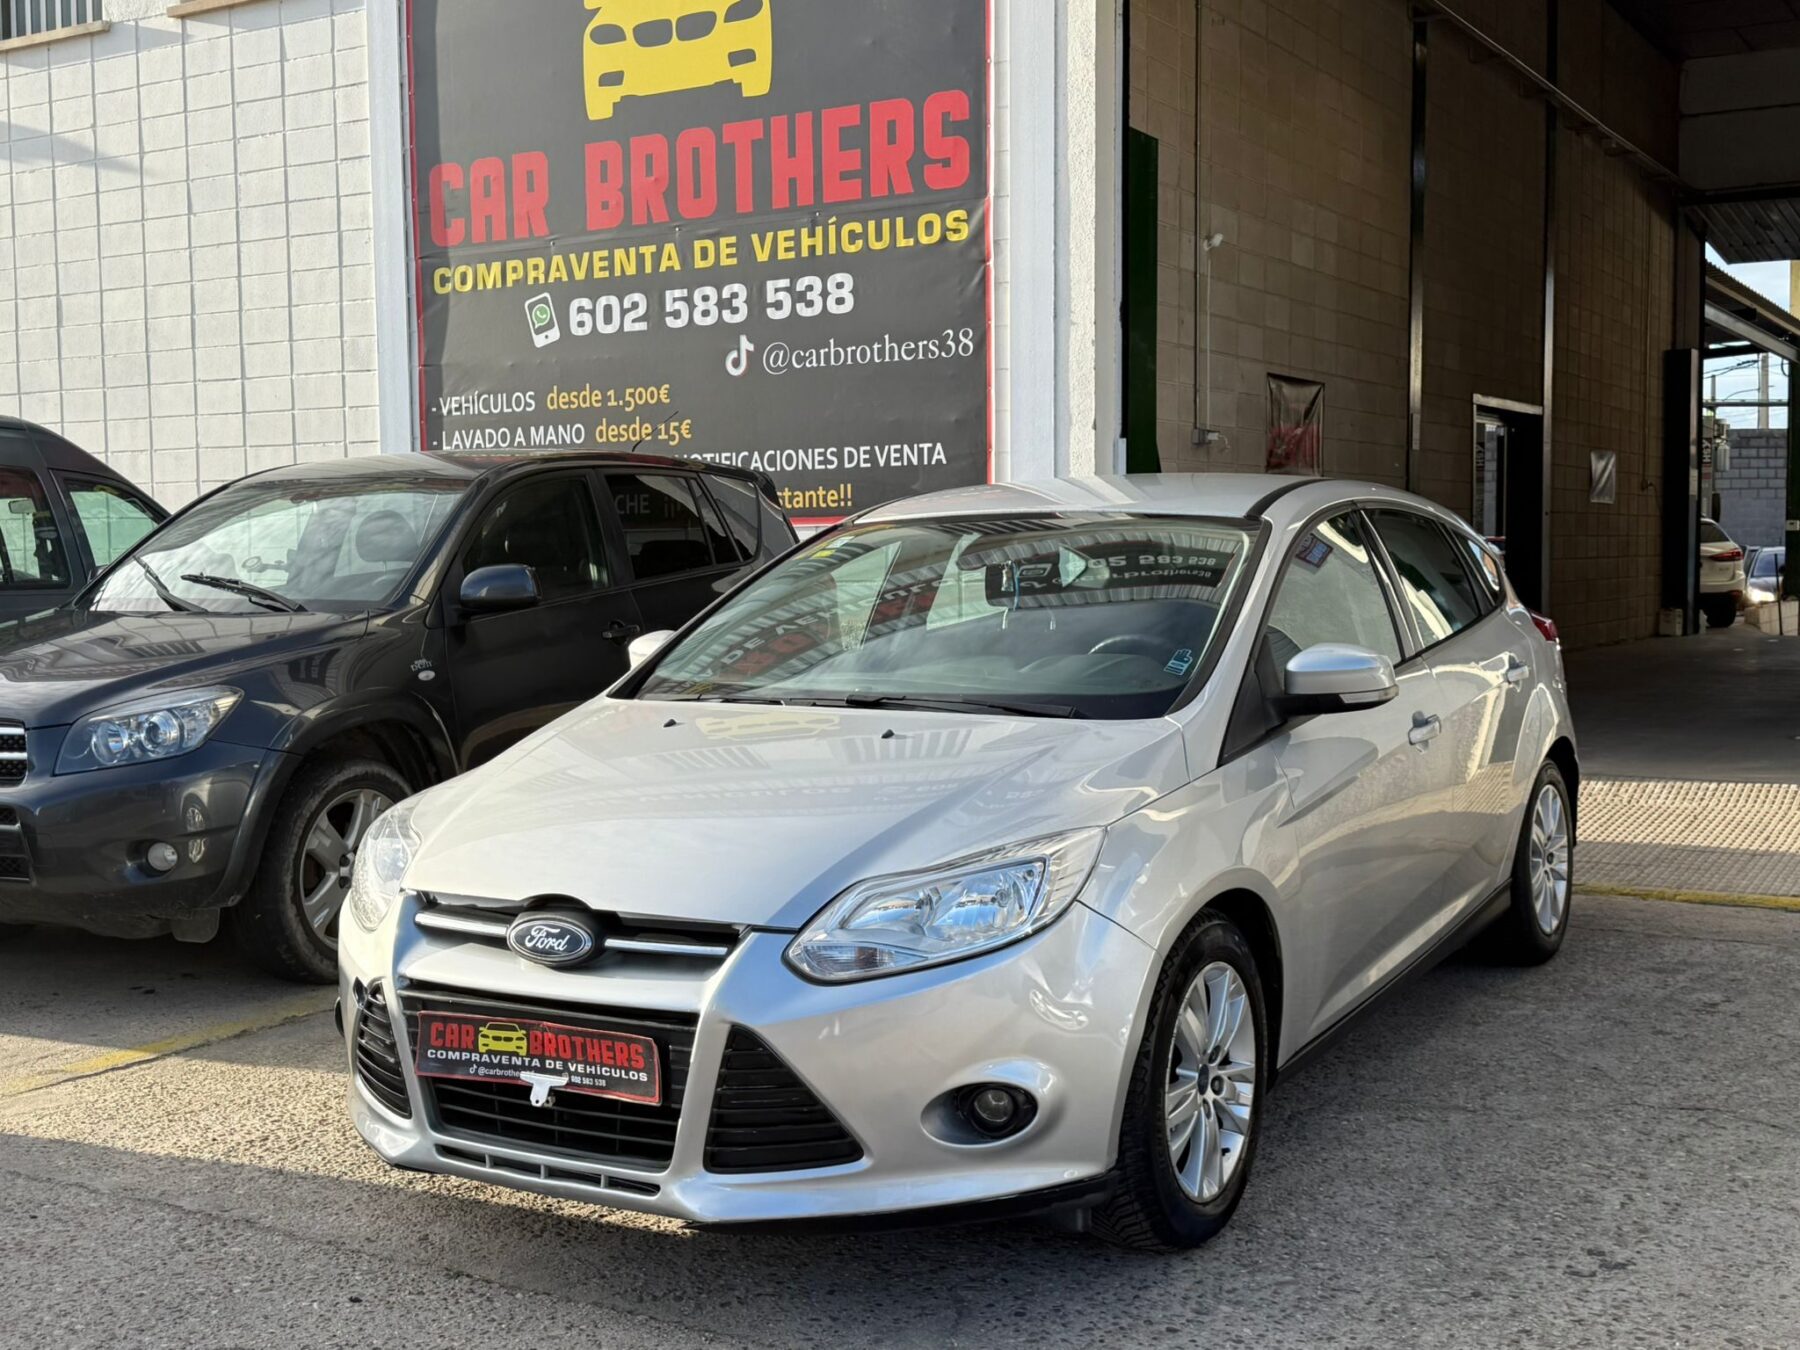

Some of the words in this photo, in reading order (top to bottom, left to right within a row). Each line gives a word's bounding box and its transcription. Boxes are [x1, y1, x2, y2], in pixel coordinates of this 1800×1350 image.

[428, 150, 550, 248] CAR
[584, 90, 971, 232] BROTHERS
[433, 243, 682, 295] COMPRAVENTA
[693, 236, 739, 269] DE
[751, 209, 970, 263] VEHÍCULOS
[569, 292, 648, 337] 602
[664, 282, 748, 328] 583
[766, 272, 855, 320] 538
[762, 327, 974, 376] @carbrothers38
[439, 390, 536, 417] VEHÍCULOS
[546, 384, 602, 410] desde
[607, 384, 671, 412] 1.500€
[441, 426, 511, 451] LAVADO
[513, 427, 530, 450] A
[529, 423, 585, 450] MANO
[595, 416, 652, 443] desde
[657, 419, 692, 446] 15€
[674, 447, 838, 473] TIFICACIONES
[843, 445, 871, 469] DE
[873, 441, 947, 468] VENTA
[525, 925, 570, 951] Ford
[427, 1049, 541, 1068] COMPRAVENTA
[545, 1060, 564, 1070] DE
[568, 1062, 648, 1082] VEHÍCULOS
[430, 1022, 475, 1049] CAR
[529, 1030, 646, 1070] BROTHERS
